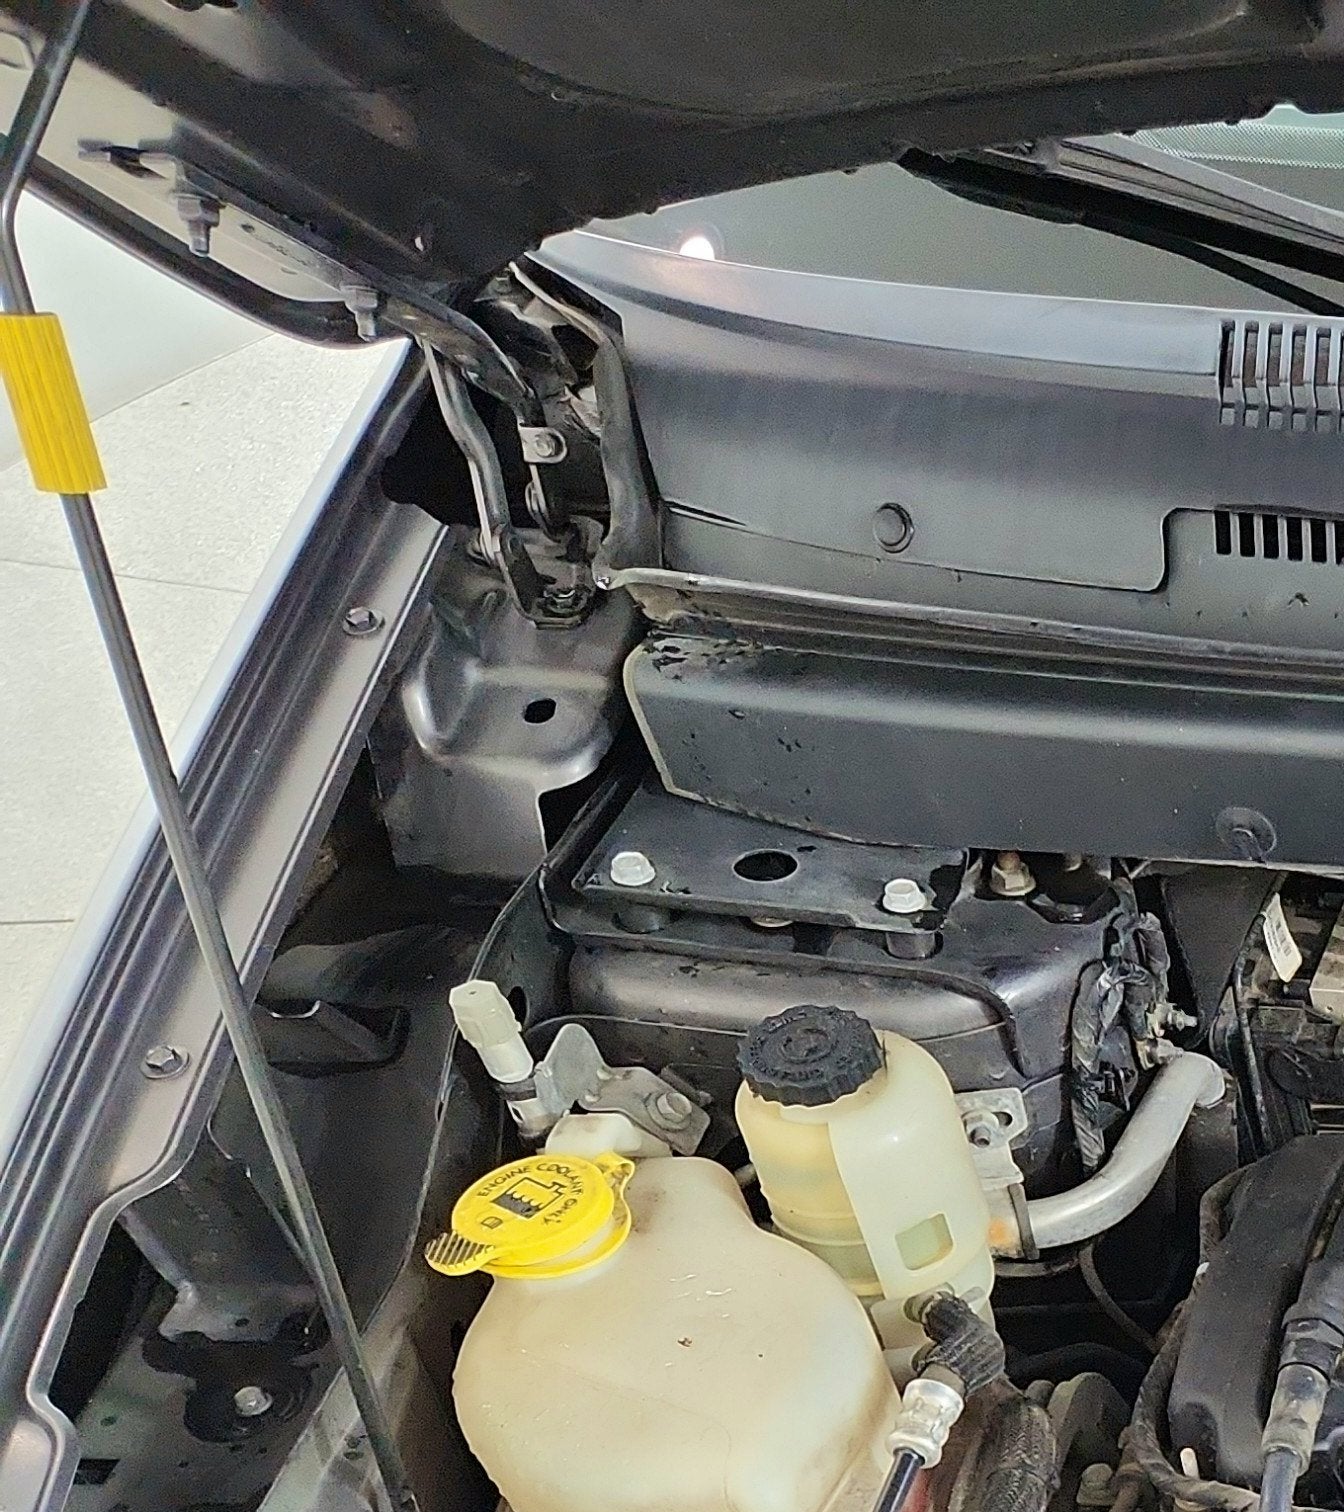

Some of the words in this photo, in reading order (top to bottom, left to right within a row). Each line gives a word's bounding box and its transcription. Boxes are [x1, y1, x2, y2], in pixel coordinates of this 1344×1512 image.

[476, 1165, 532, 1197] ENGINE
[536, 1163, 584, 1195] COOLANT
[543, 1198, 578, 1226] ONLY
